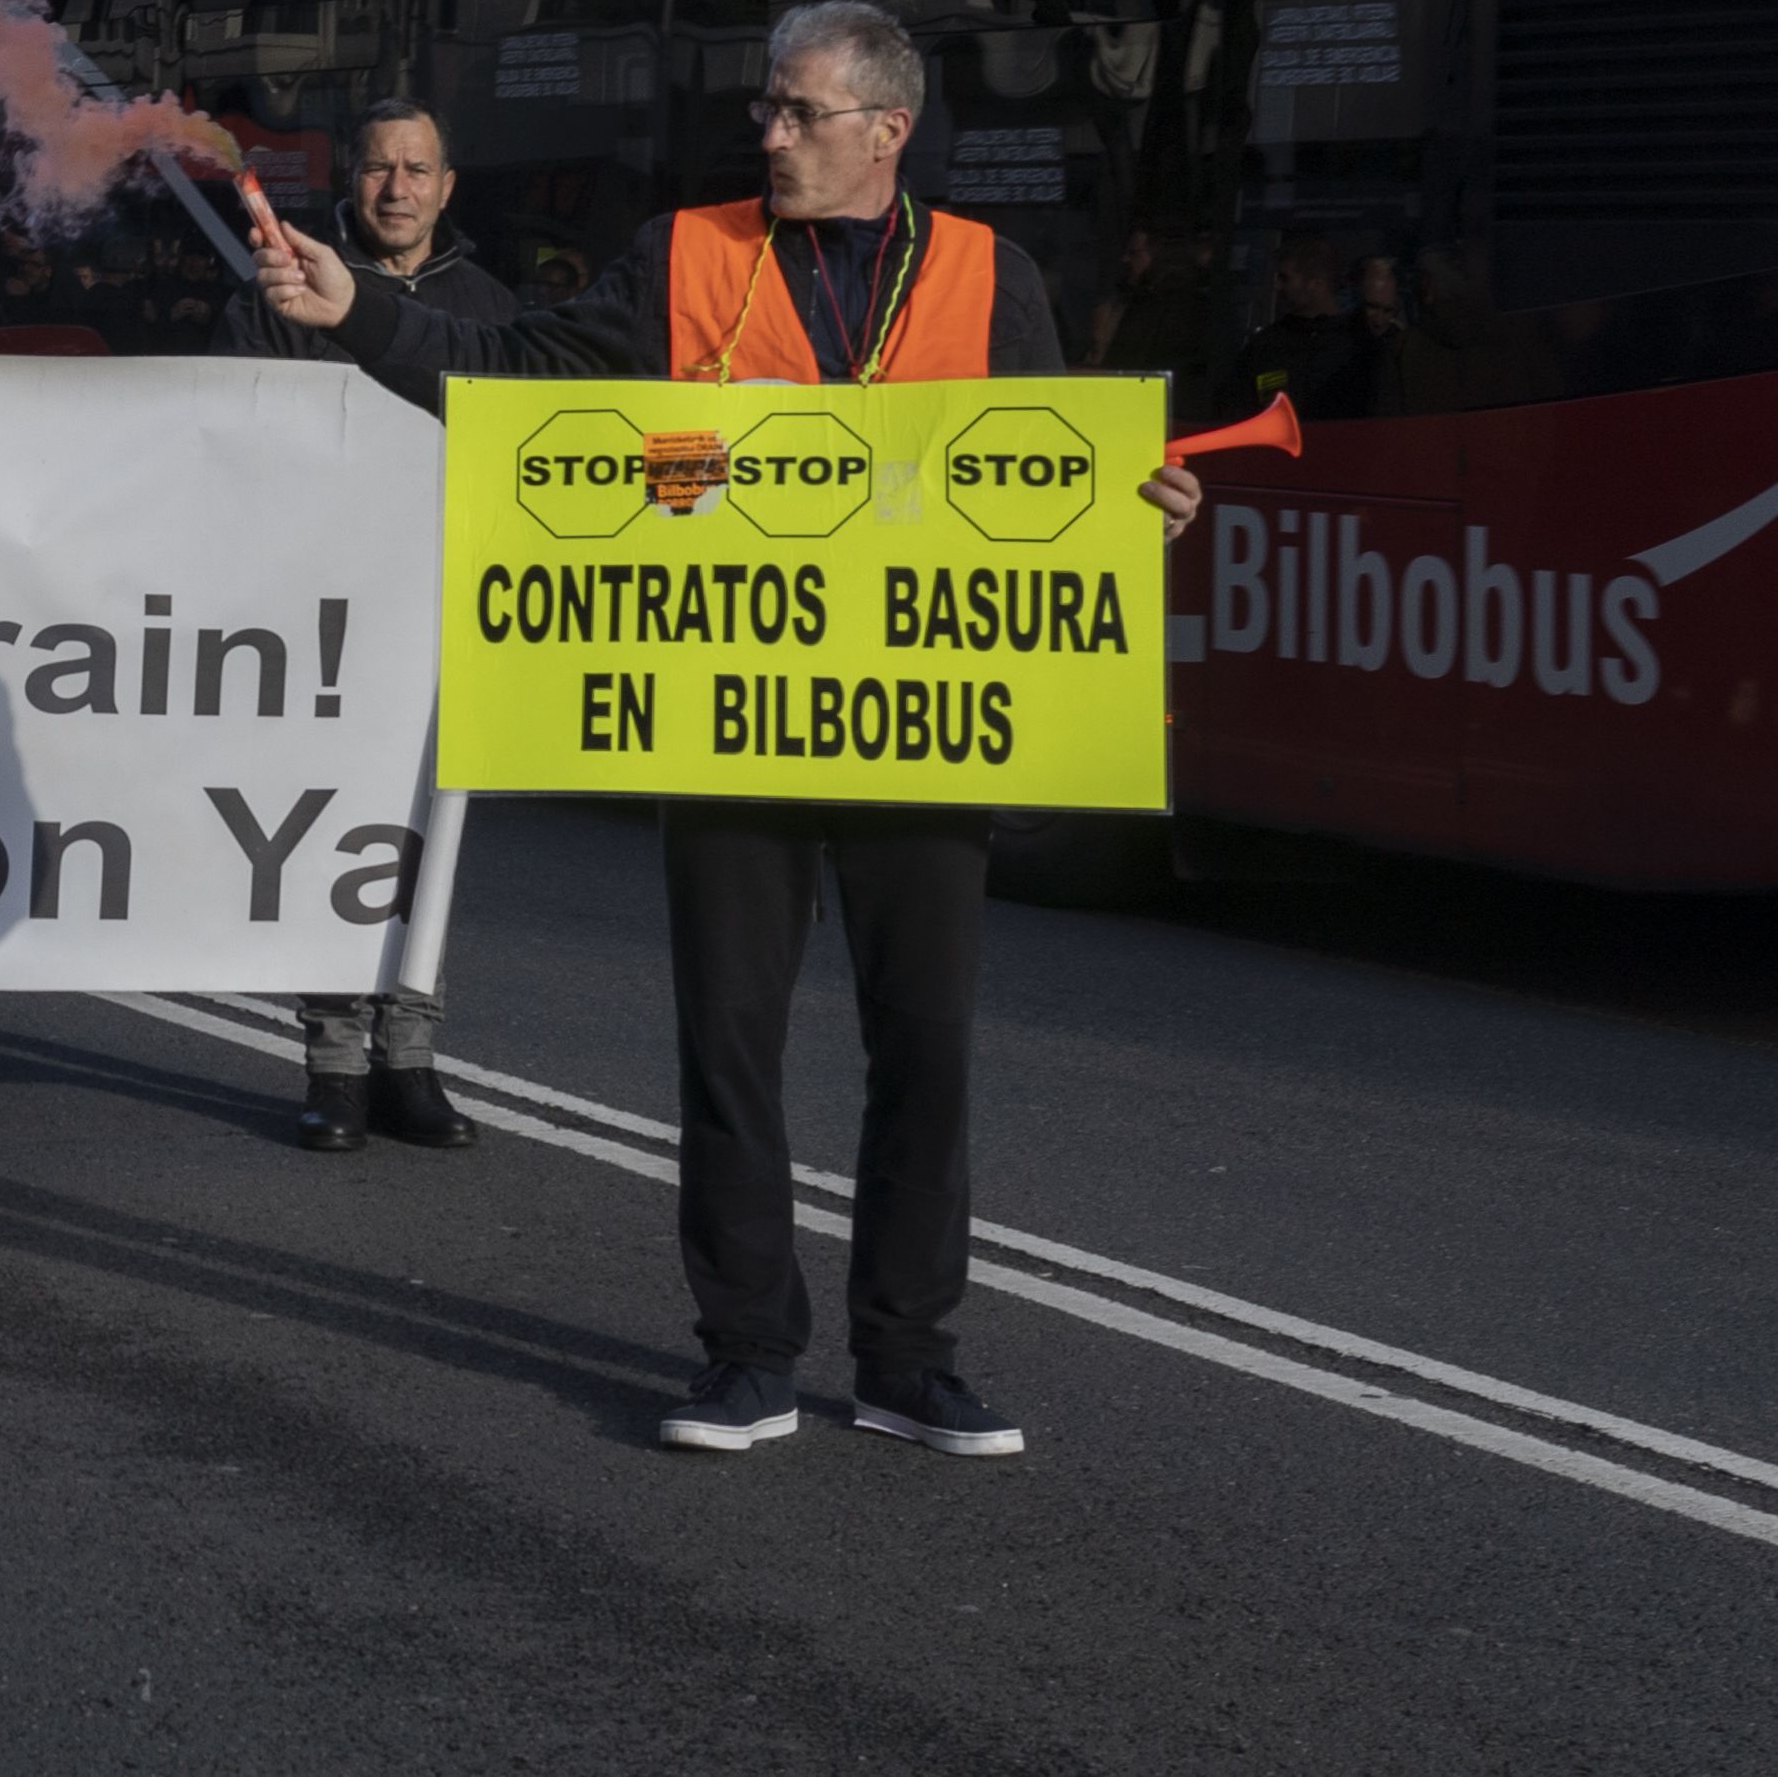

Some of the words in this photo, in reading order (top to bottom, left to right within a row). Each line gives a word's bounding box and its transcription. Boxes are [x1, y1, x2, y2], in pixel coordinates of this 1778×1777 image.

[522, 455, 646, 486] STOP
[732, 455, 867, 486] STOP
[951, 454, 1090, 487] STOP
[478, 564, 827, 646] CONTRATOS
[885, 566, 1129, 655] BASURA
[1210, 502, 1664, 707] Bilbobus
[581, 673, 655, 753] EN
[713, 674, 1013, 766] BILBOBUS
[204, 787, 427, 926] Ya
